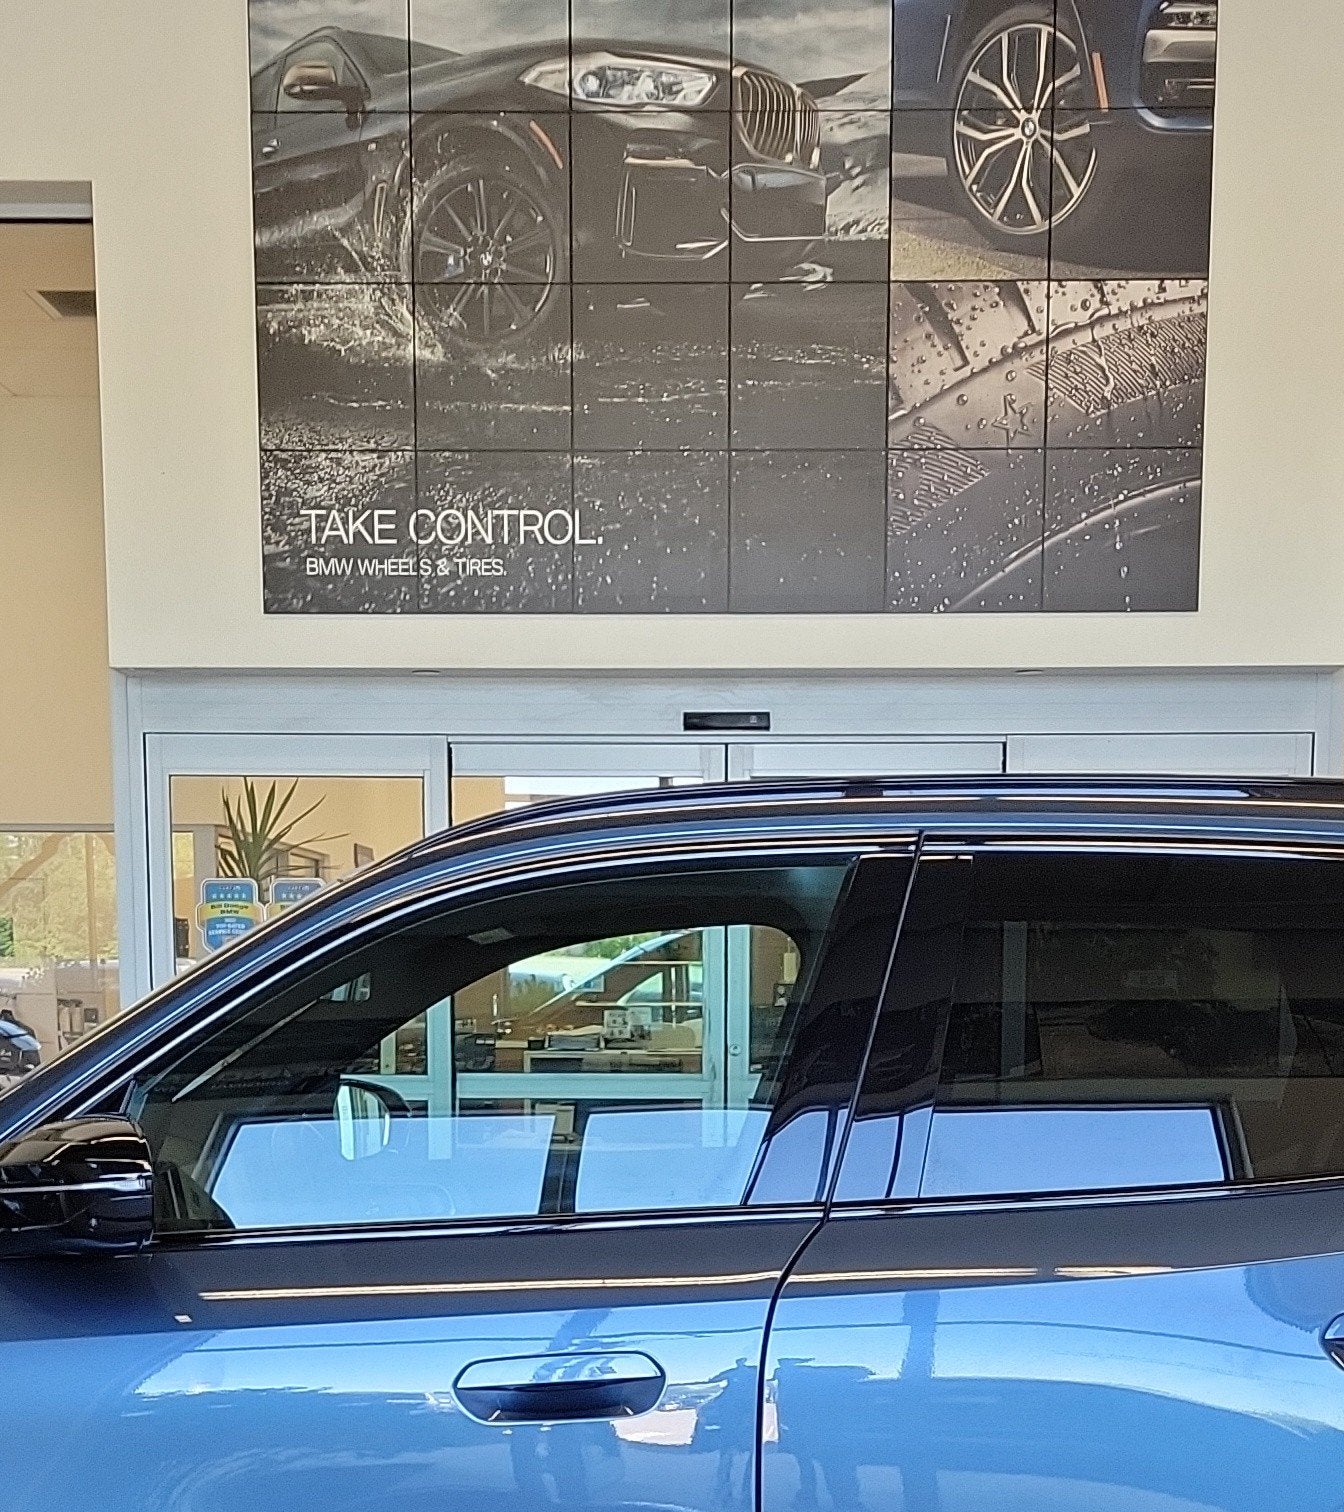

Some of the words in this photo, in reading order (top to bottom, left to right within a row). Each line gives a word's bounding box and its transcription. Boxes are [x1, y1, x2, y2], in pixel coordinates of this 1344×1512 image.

[300, 508, 398, 545] TAKE
[408, 508, 604, 545] CONTROL.
[305, 557, 354, 576] BMW
[357, 557, 432, 576] WHEELS
[436, 558, 450, 576] &
[455, 557, 507, 576] TIRES.
